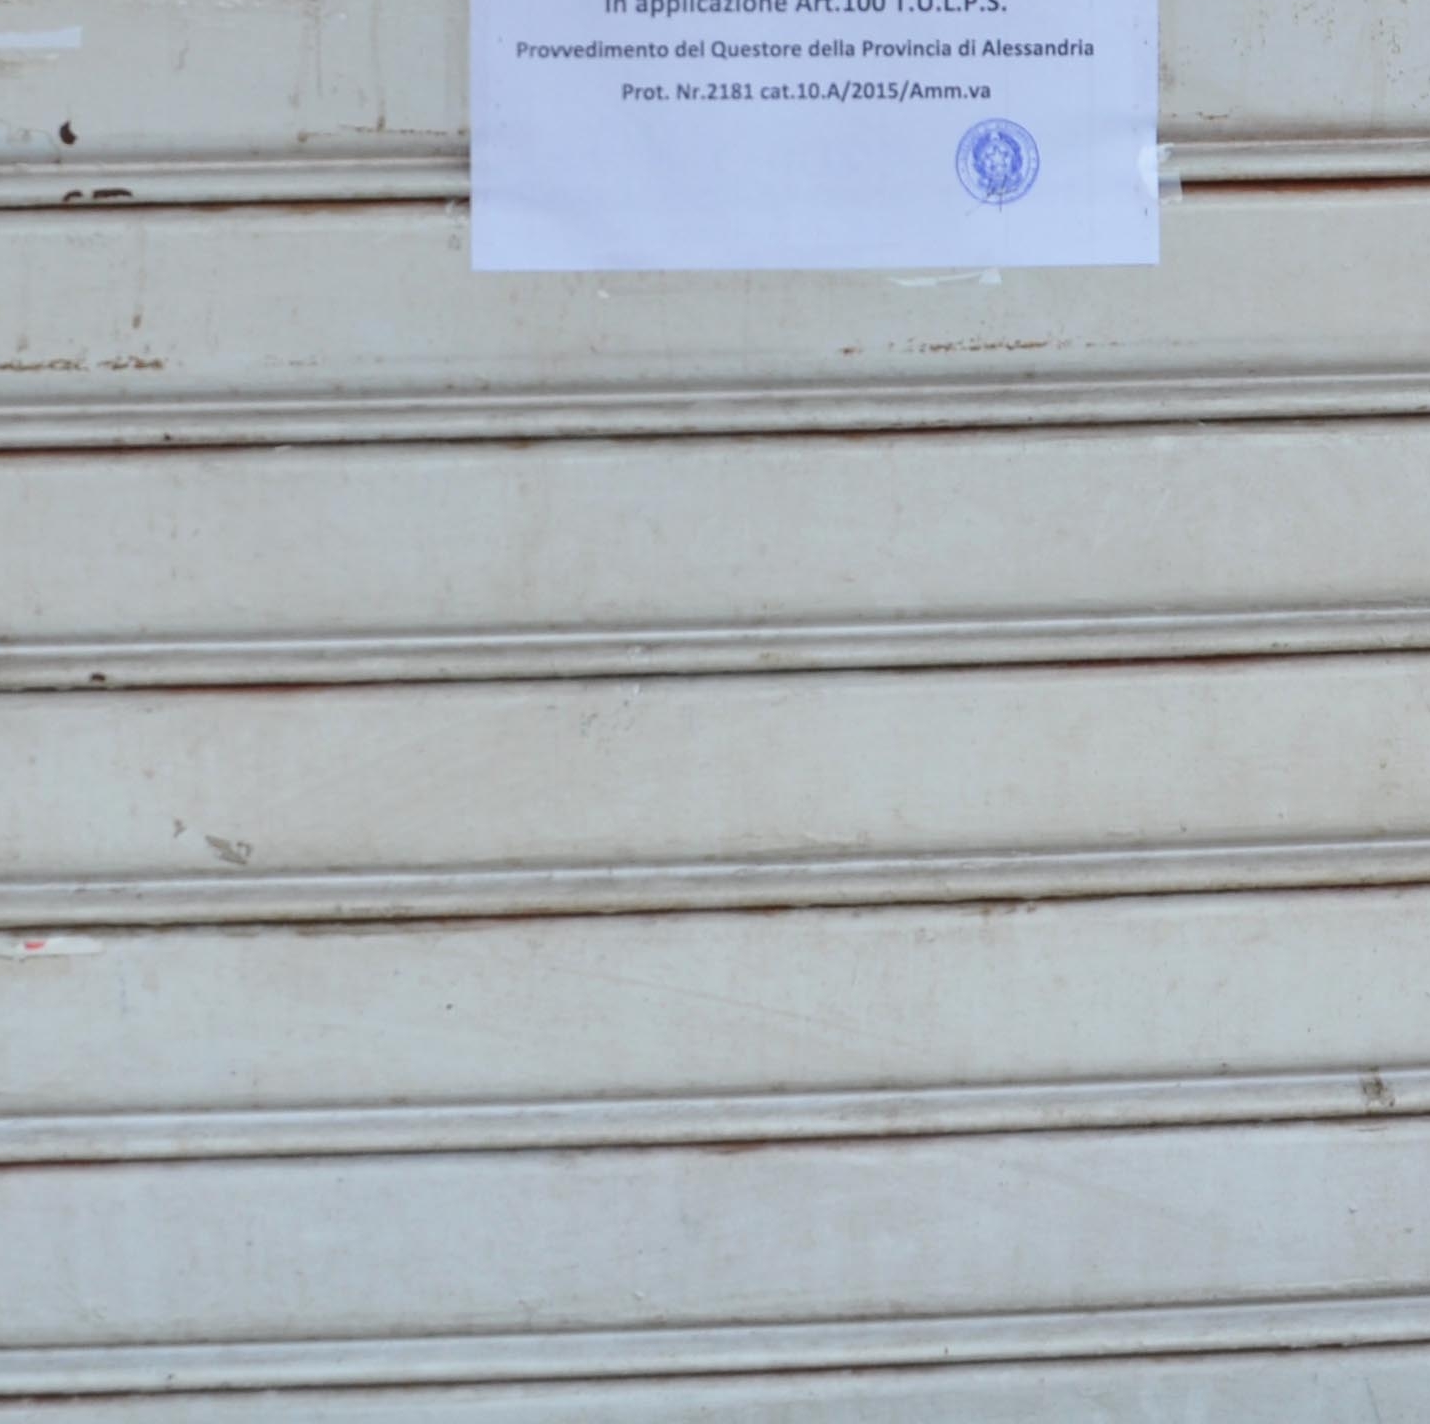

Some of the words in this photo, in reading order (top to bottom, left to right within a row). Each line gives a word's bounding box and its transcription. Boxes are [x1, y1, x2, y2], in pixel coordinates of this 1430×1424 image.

[516, 39, 670, 58] Provvedimento
[674, 39, 705, 58] del
[710, 39, 802, 59] Questore
[807, 39, 856, 57] della
[862, 39, 952, 57] Provincia
[957, 39, 976, 57] di
[981, 38, 1095, 57] Alessandria
[621, 83, 670, 100] Prot.
[676, 82, 753, 100] Nr.2181
[760, 79, 991, 102] cat.10.A/2015/Amm.va
